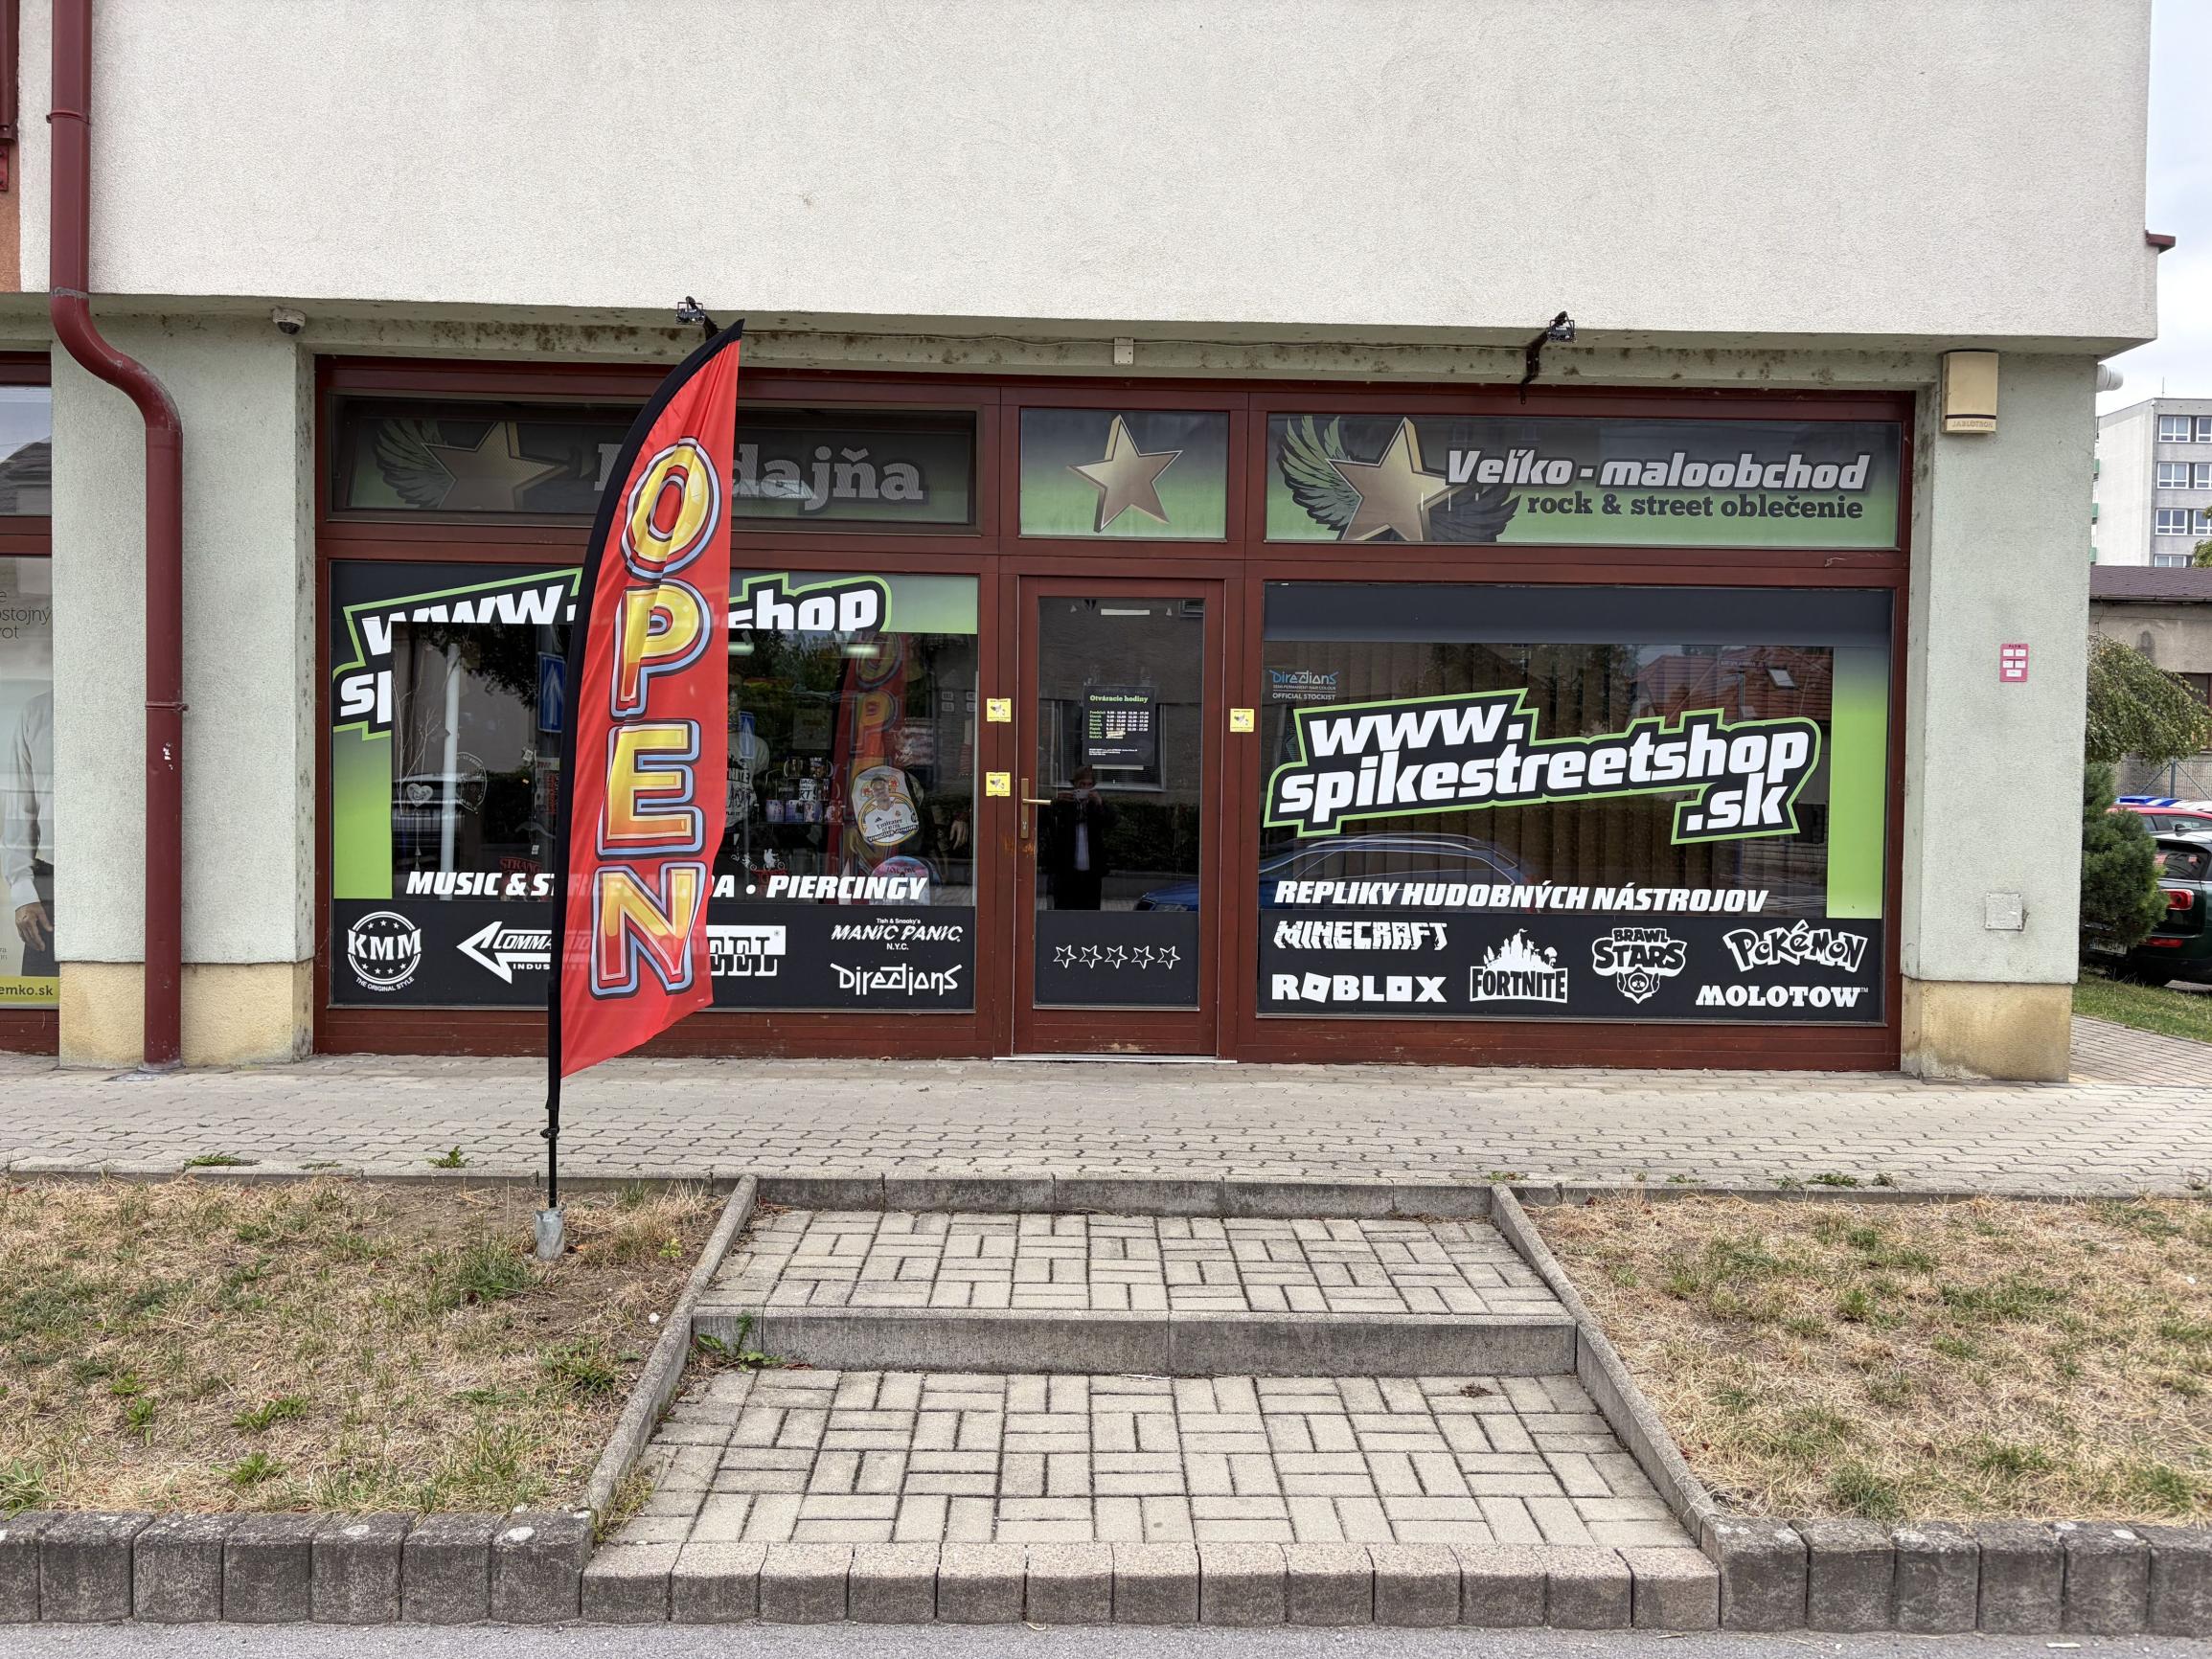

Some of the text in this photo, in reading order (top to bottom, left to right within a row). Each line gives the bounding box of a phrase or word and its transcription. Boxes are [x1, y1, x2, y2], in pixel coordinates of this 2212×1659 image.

[1448, 448, 1574, 484] Veľko
[1600, 452, 1870, 489] maloobchod
[1528, 491, 1863, 519] rock & street oblečenie
[0, 606, 52, 625] stojný
[0, 625, 19, 639] ot
[590, 436, 721, 1000] OPEN
[1309, 705, 1525, 758] www.
[1279, 724, 1809, 823] spikestreetshop
[1686, 780, 1784, 830] .sk
[406, 871, 502, 896] MUSIC
[505, 873, 526, 896] &
[766, 875, 927, 899] PIERCINGY
[1274, 879, 1768, 912] REPLIKY HUDOBNÝCH NÁSTROJOV
[348, 928, 422, 961] KMM
[831, 924, 900, 941] MANIC
[1273, 920, 1448, 951] MINECRAFT
[1612, 927, 1671, 943] BRAWL
[1592, 940, 1687, 971] STARS
[355, 977, 367, 987] THE
[397, 976, 415, 989] STYLE
[1271, 971, 1448, 1004] ROBLOX
[1471, 967, 1567, 1002] FORTNITE
